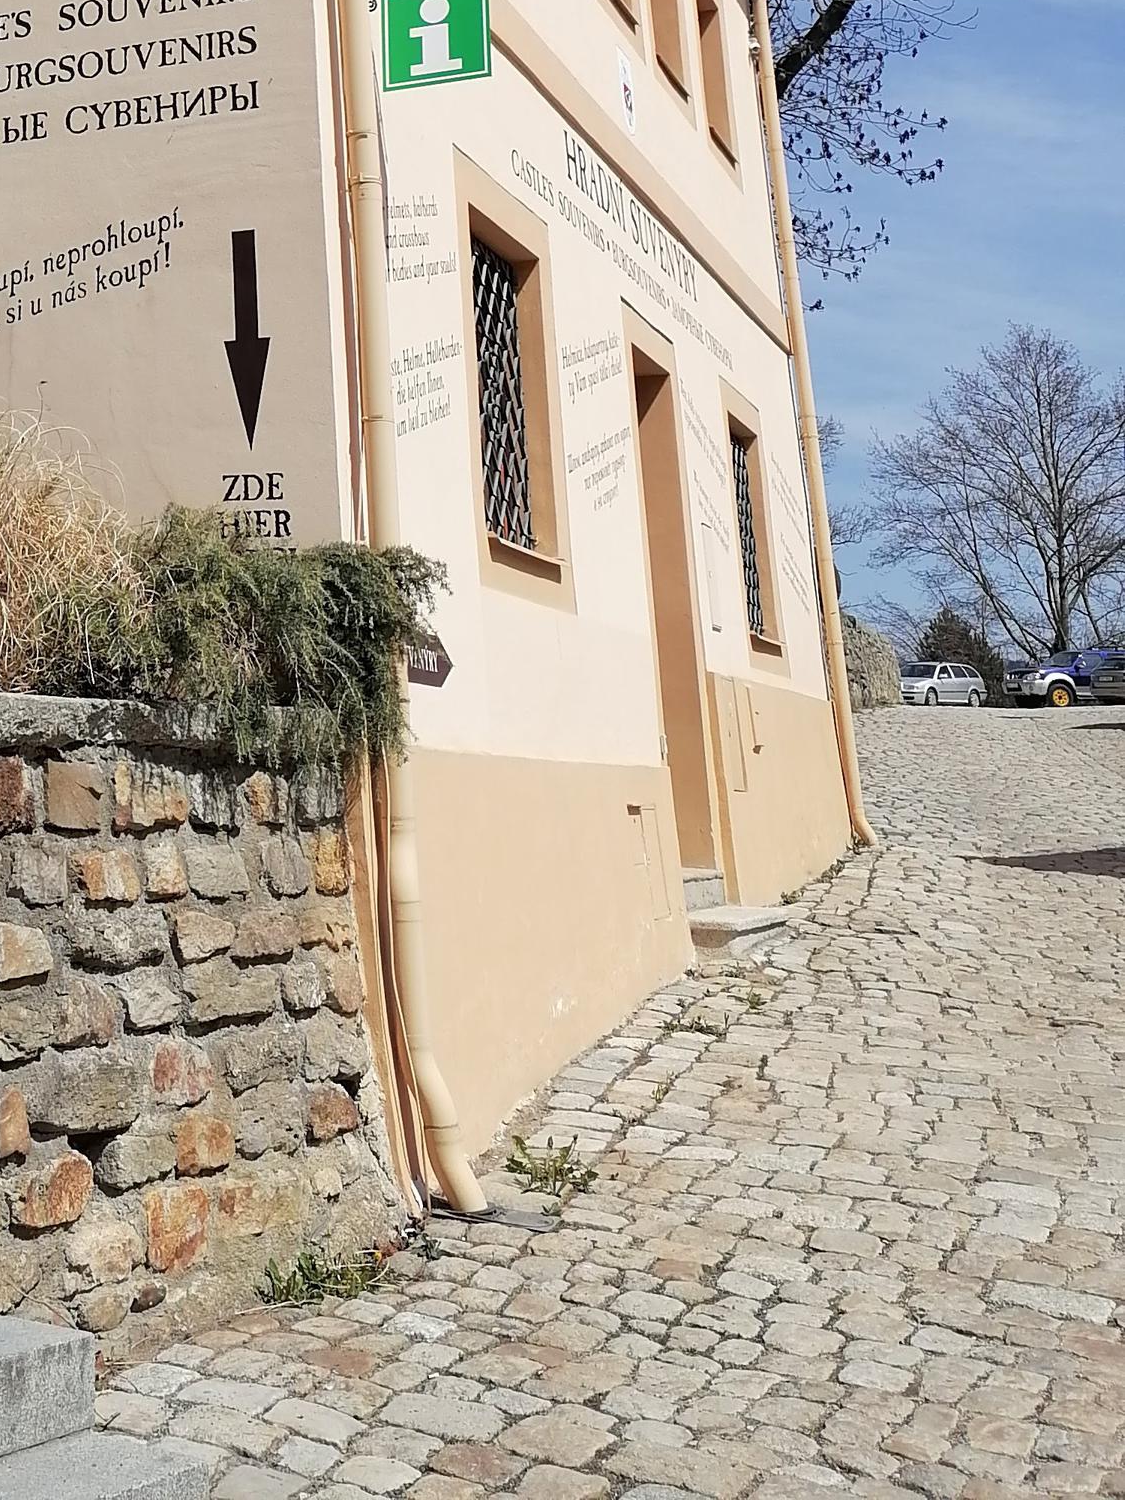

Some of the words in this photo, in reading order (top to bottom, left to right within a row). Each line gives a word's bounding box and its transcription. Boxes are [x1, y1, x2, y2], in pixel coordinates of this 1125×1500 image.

[65, 81, 259, 134] СУВЕНИРЫ
[43, 206, 184, 277] neprohloupí,
[557, 191, 605, 252] SOUVENIRS
[6, 299, 22, 324] si
[31, 298, 42, 315] u
[51, 280, 87, 308] nás
[96, 242, 170, 294] koupí!
[222, 472, 284, 502] ZDE
[217, 509, 292, 539] HIER
